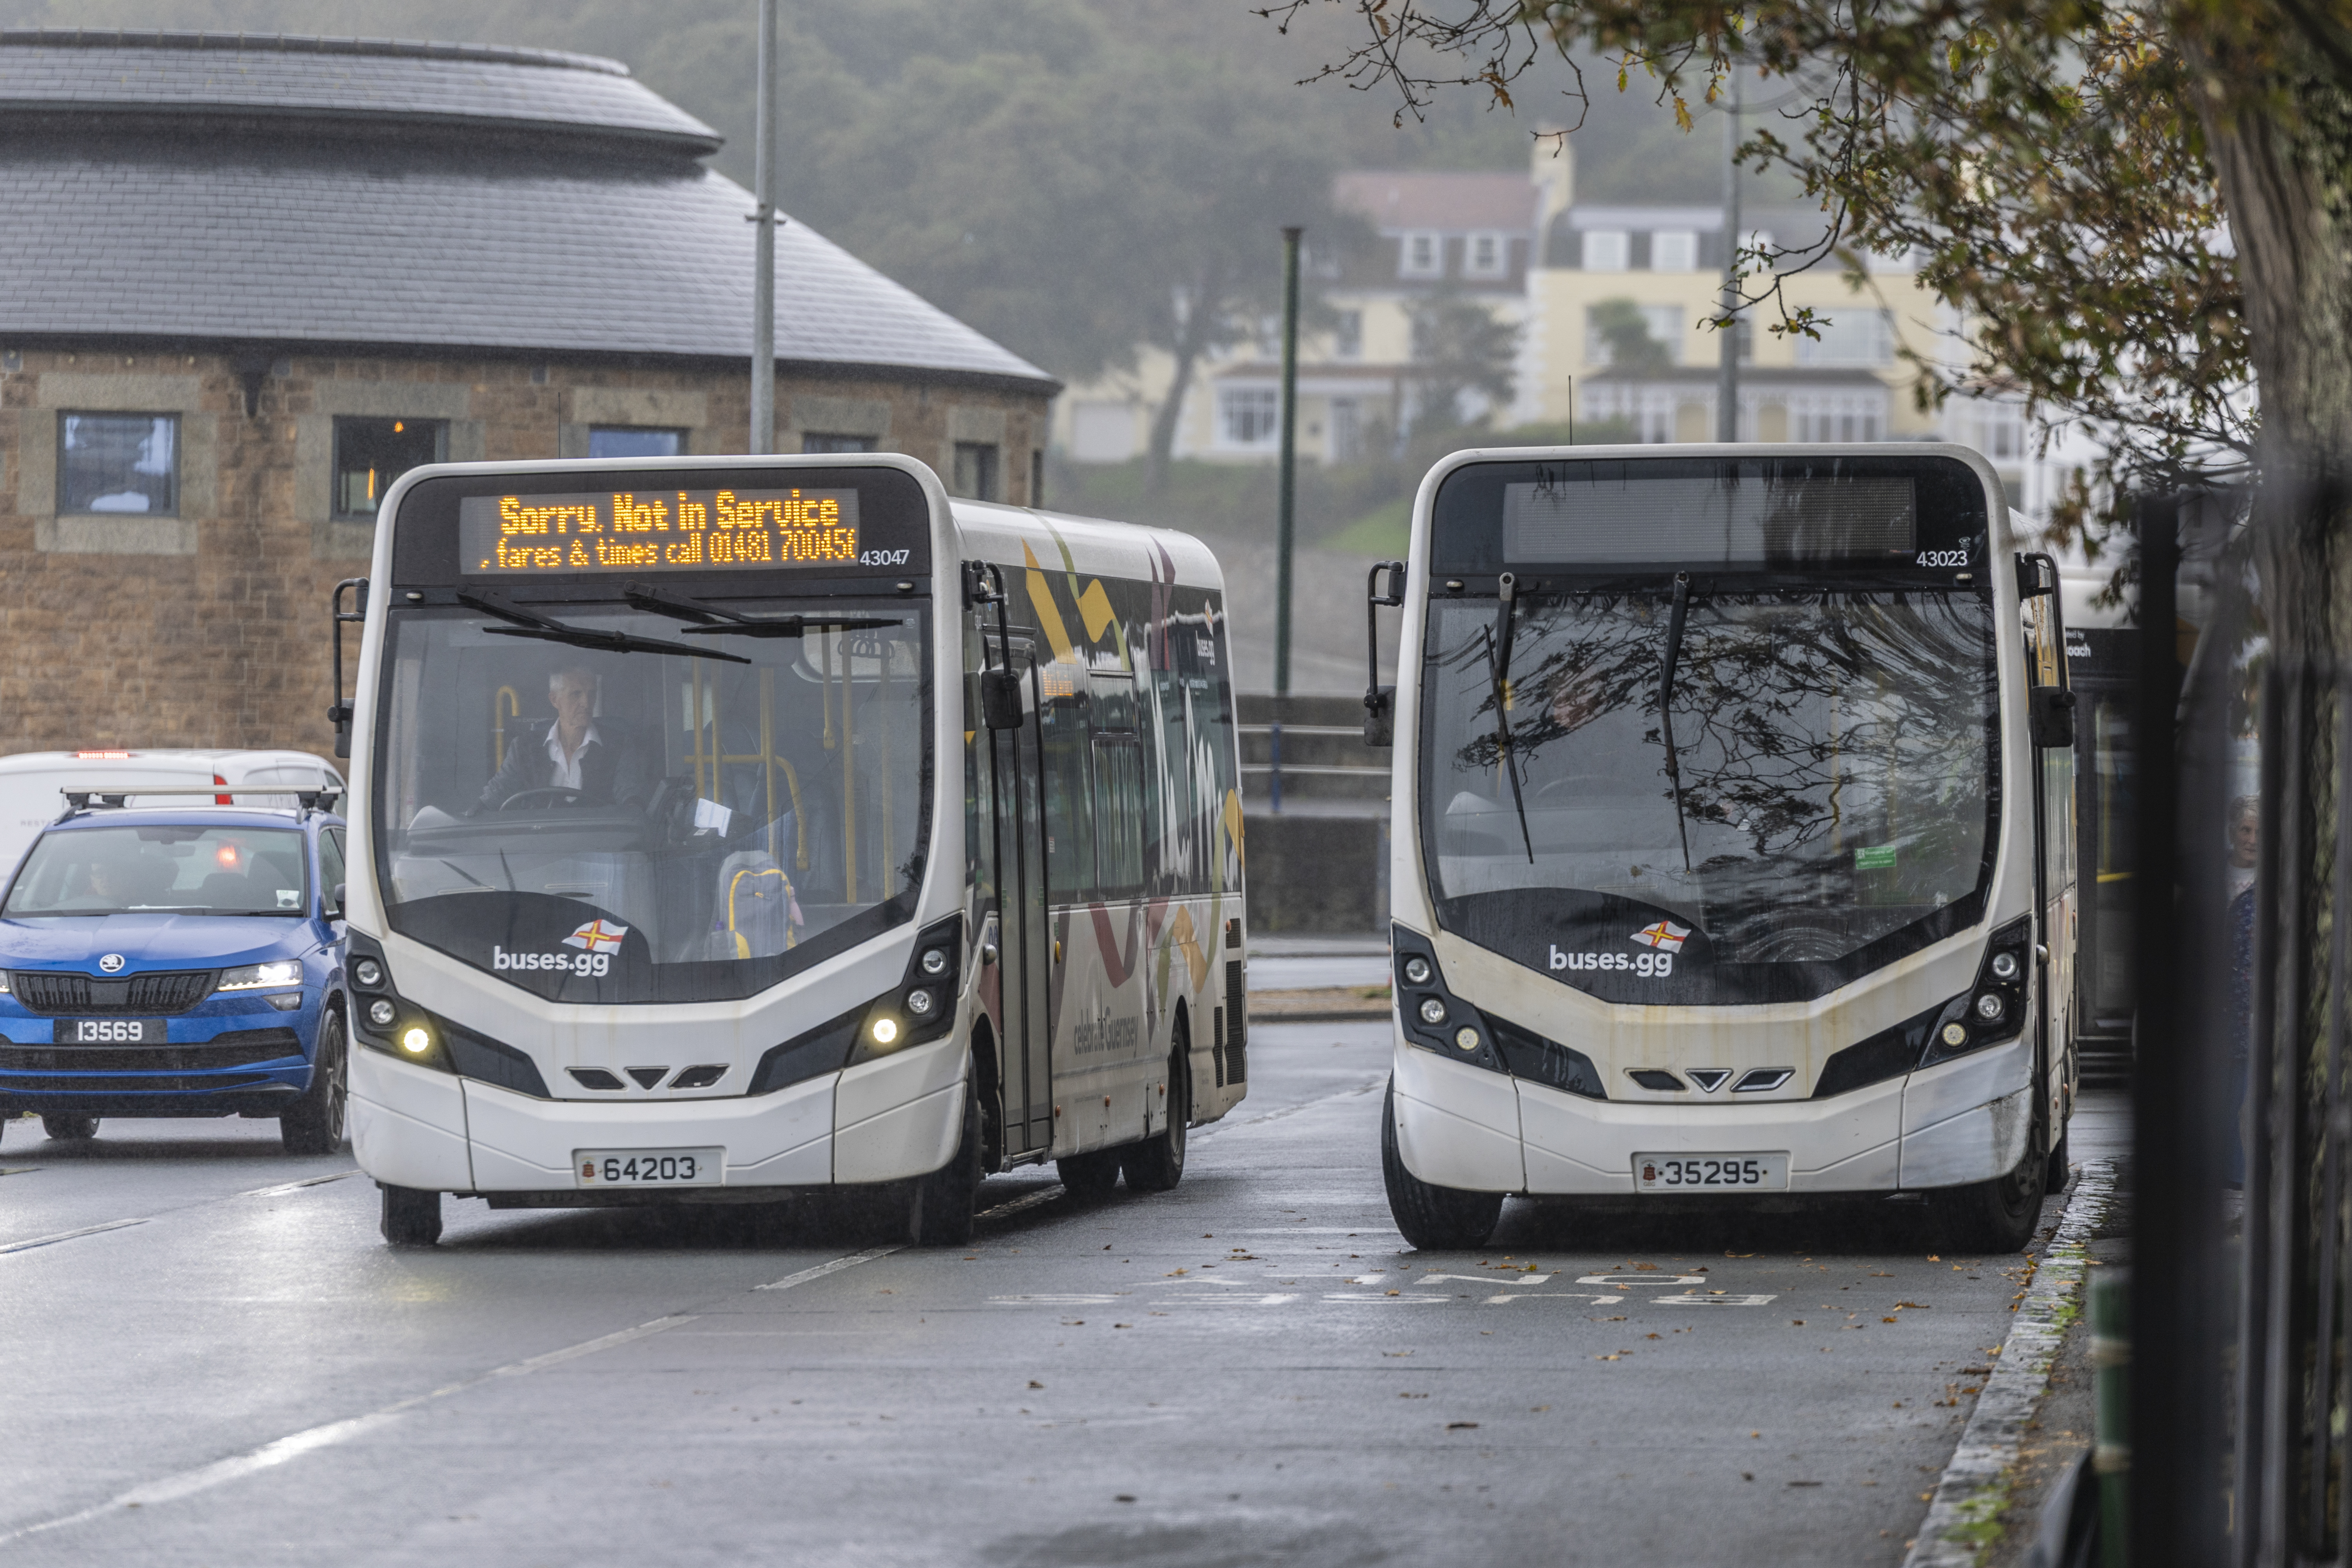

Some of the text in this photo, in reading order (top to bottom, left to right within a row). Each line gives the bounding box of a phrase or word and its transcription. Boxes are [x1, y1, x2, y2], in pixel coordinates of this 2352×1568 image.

[614, 494, 668, 532] Not
[679, 492, 706, 530] in
[716, 488, 838, 529] Service
[496, 537, 561, 568] fares
[569, 539, 588, 566] &
[596, 538, 658, 565] times
[666, 532, 702, 563] call
[709, 530, 772, 561] 01481
[860, 549, 910, 566] 43047
[1916, 550, 1968, 567] 43023
[2066, 642, 2091, 657] oach
[493, 945, 609, 977] buses.gg
[1550, 944, 1673, 977] buses.gg
[78, 1021, 143, 1041] 13569
[603, 1156, 695, 1181] 64203
[1665, 1160, 1759, 1185] 35295
[1126, 1274, 1706, 1286] ONLY
[982, 1293, 1779, 1306] BUSES
